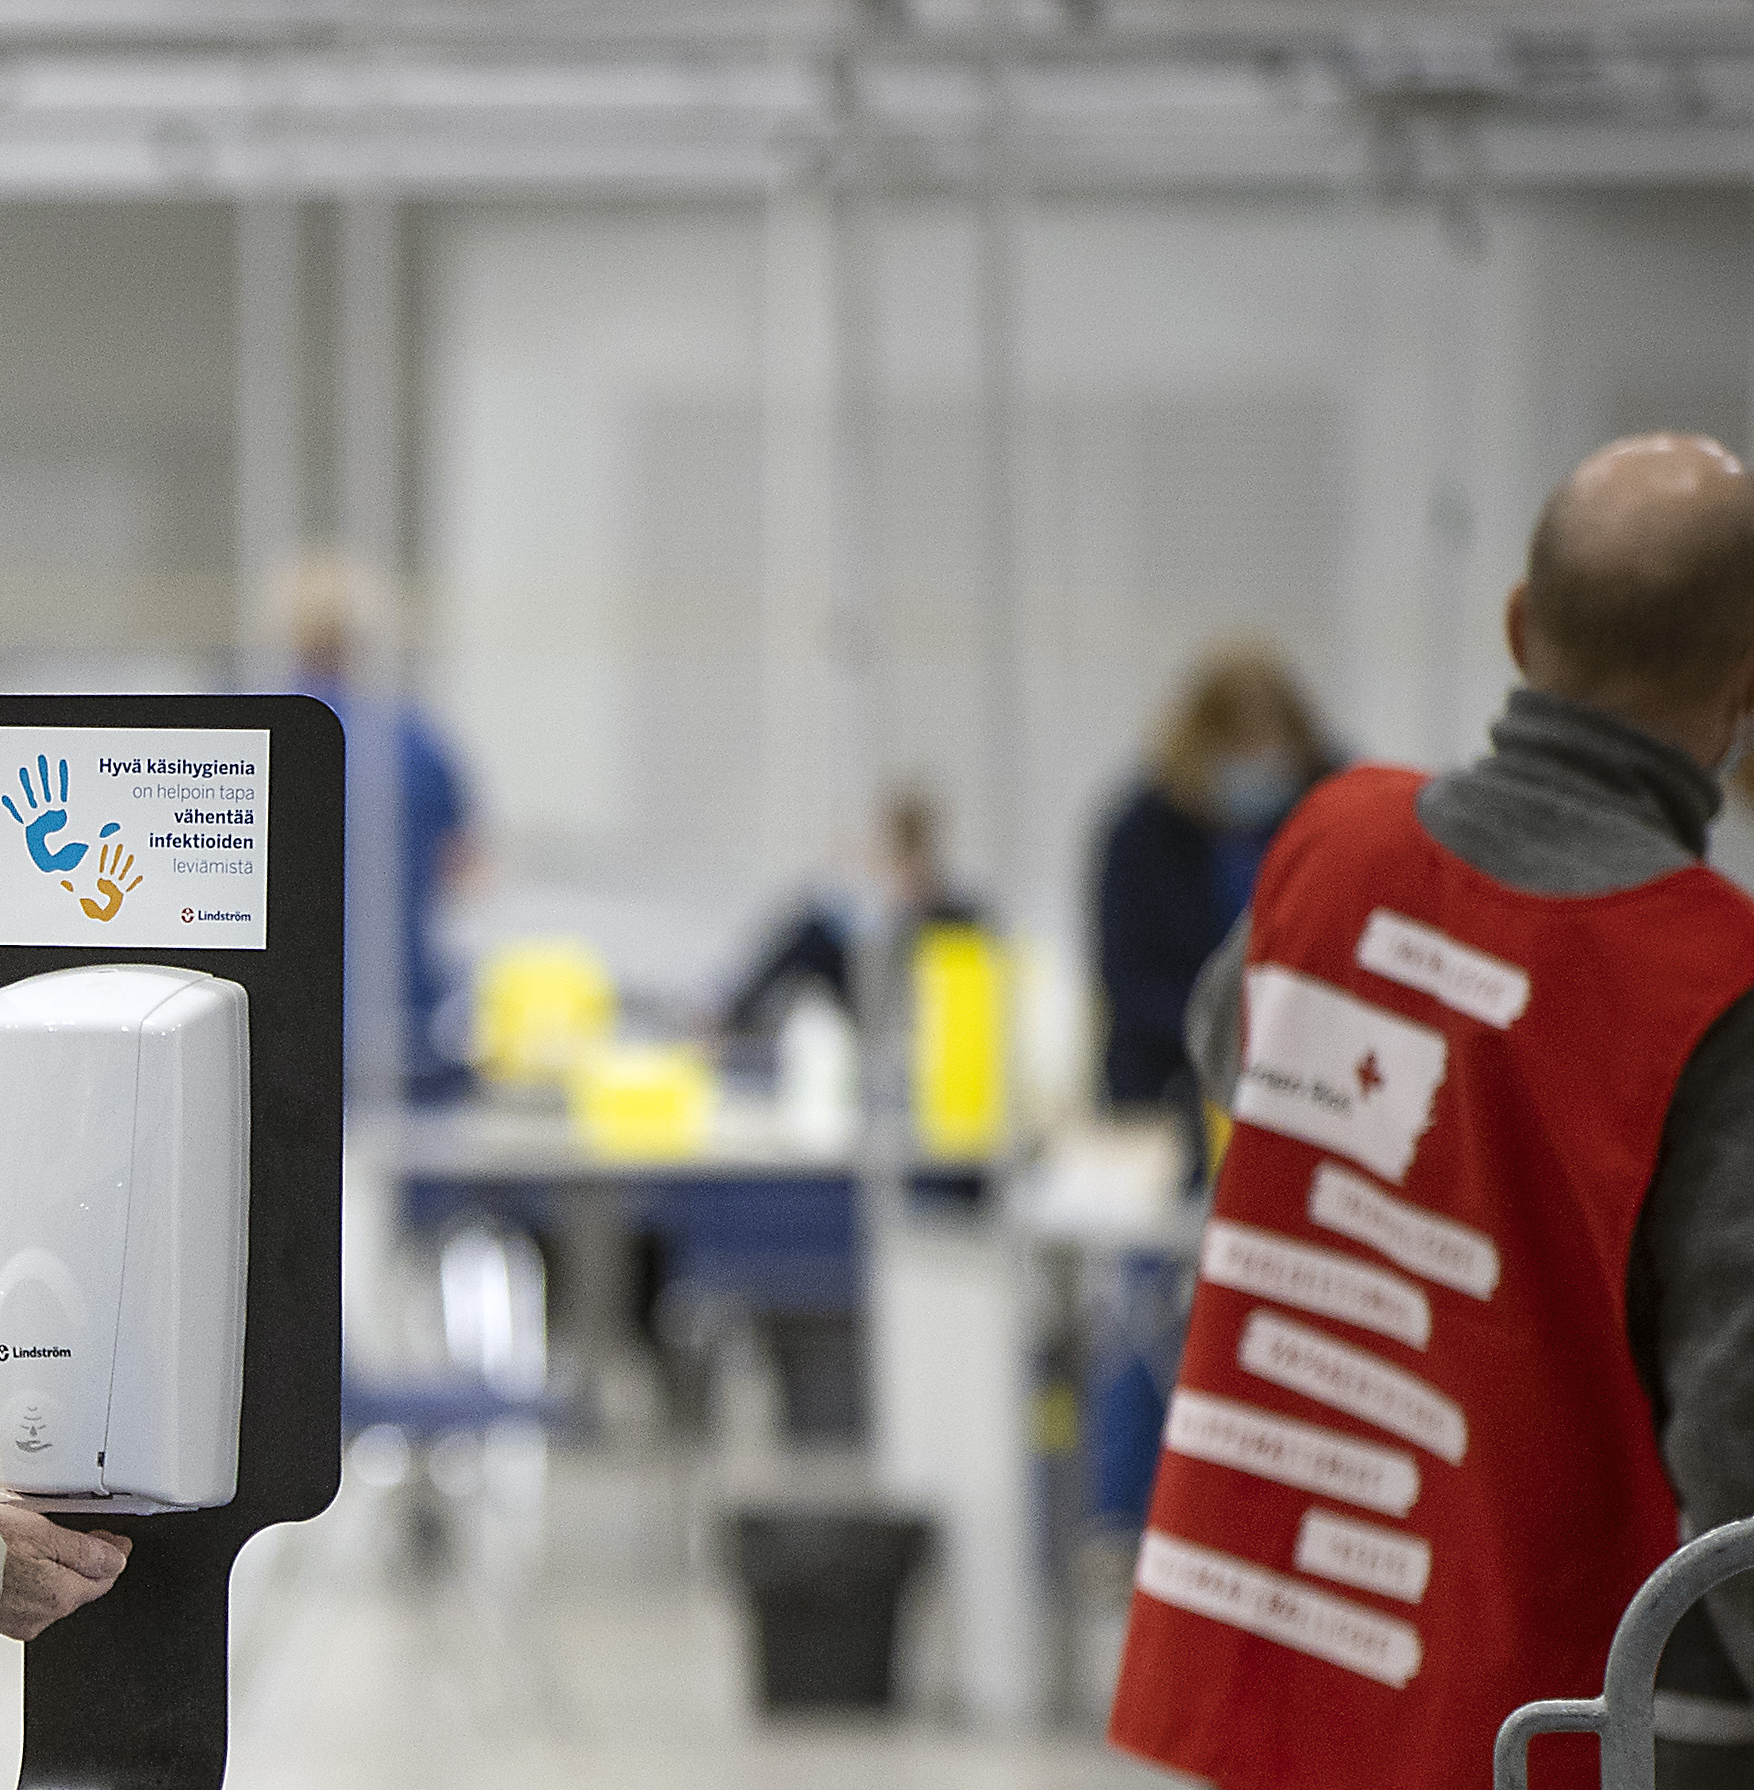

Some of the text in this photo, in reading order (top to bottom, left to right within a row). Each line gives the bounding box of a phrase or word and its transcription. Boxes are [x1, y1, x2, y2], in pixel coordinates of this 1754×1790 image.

[98, 758, 255, 778] Hyvä käsihygienia
[132, 784, 255, 803] on helpoin tapa
[174, 809, 254, 825] vähentää
[149, 832, 254, 850] infektioiden
[172, 858, 254, 875] leviämistä
[197, 910, 252, 922] Lindström
[12, 1346, 72, 1359] Lindström
